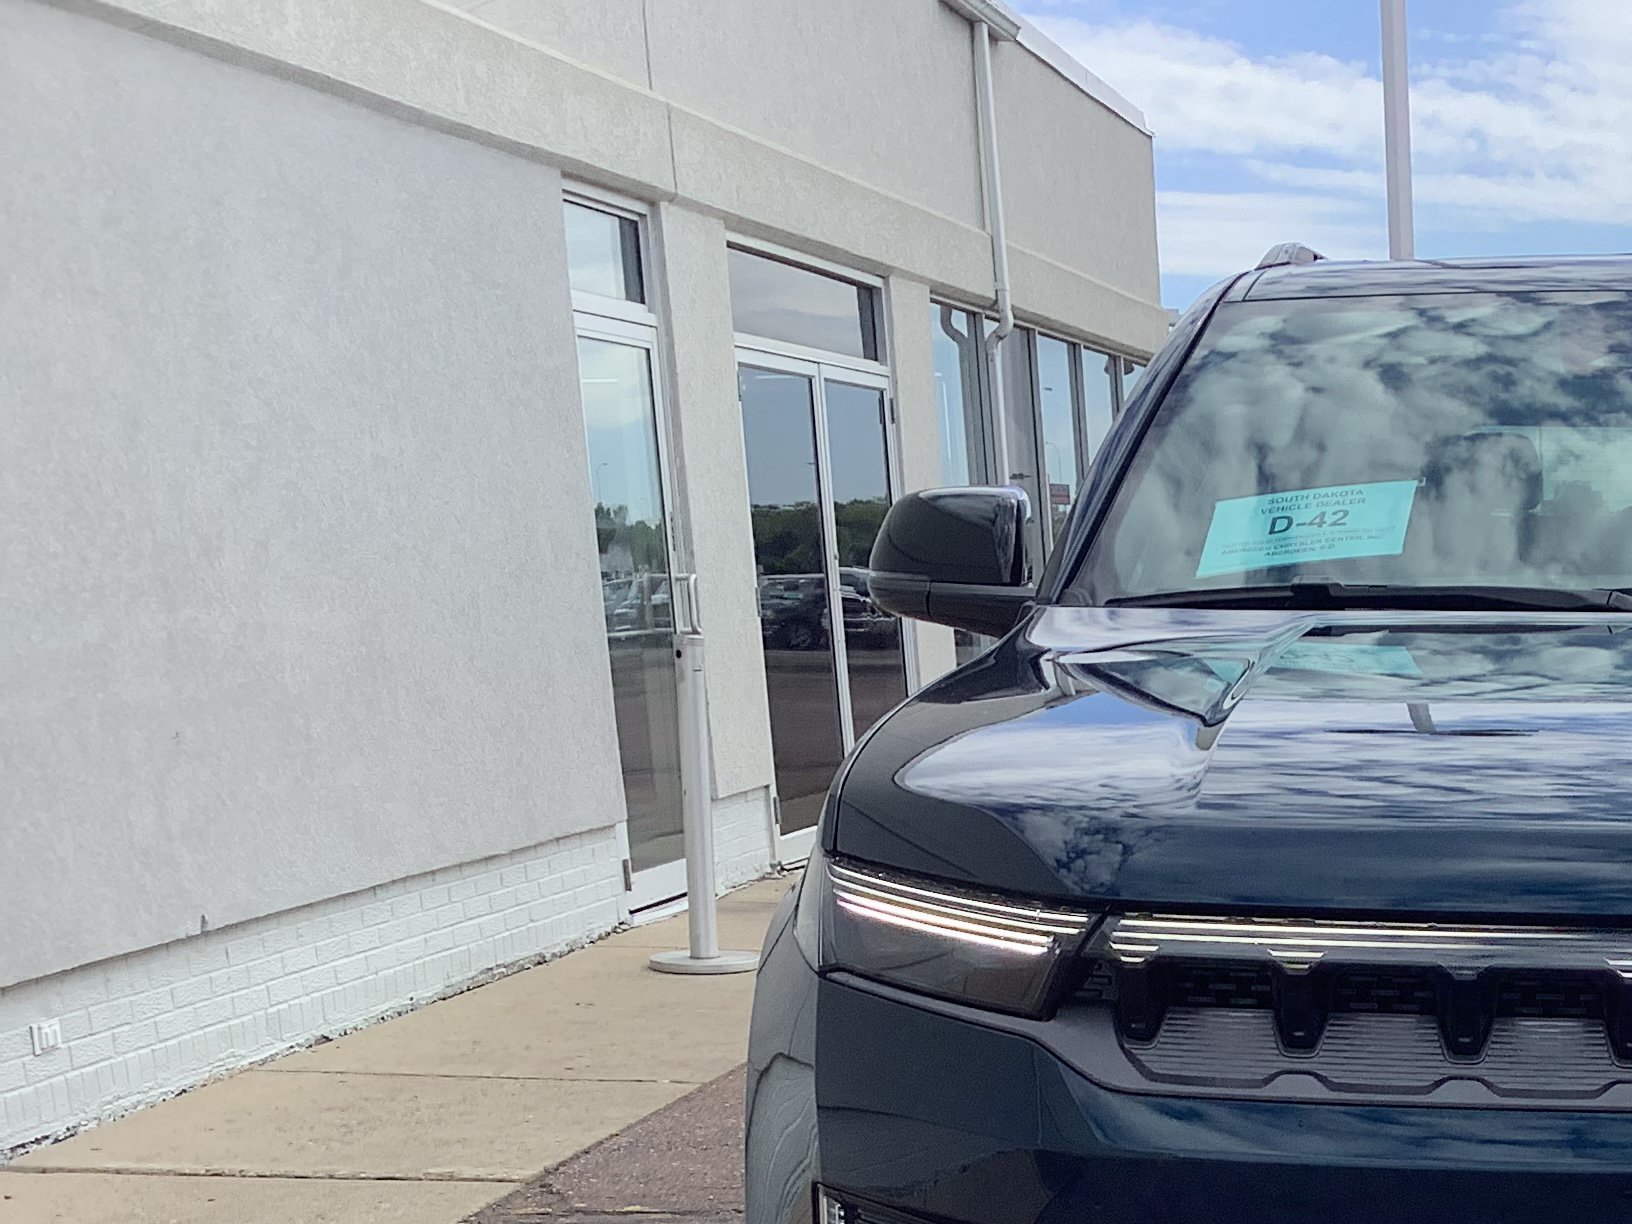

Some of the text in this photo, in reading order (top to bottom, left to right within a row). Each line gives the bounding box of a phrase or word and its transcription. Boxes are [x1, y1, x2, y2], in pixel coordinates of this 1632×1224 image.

[1260, 497, 1366, 515] VEHICLE DEALER
[1267, 489, 1364, 505] SOUTH DAKOTA
[1268, 509, 1350, 535] D-42
